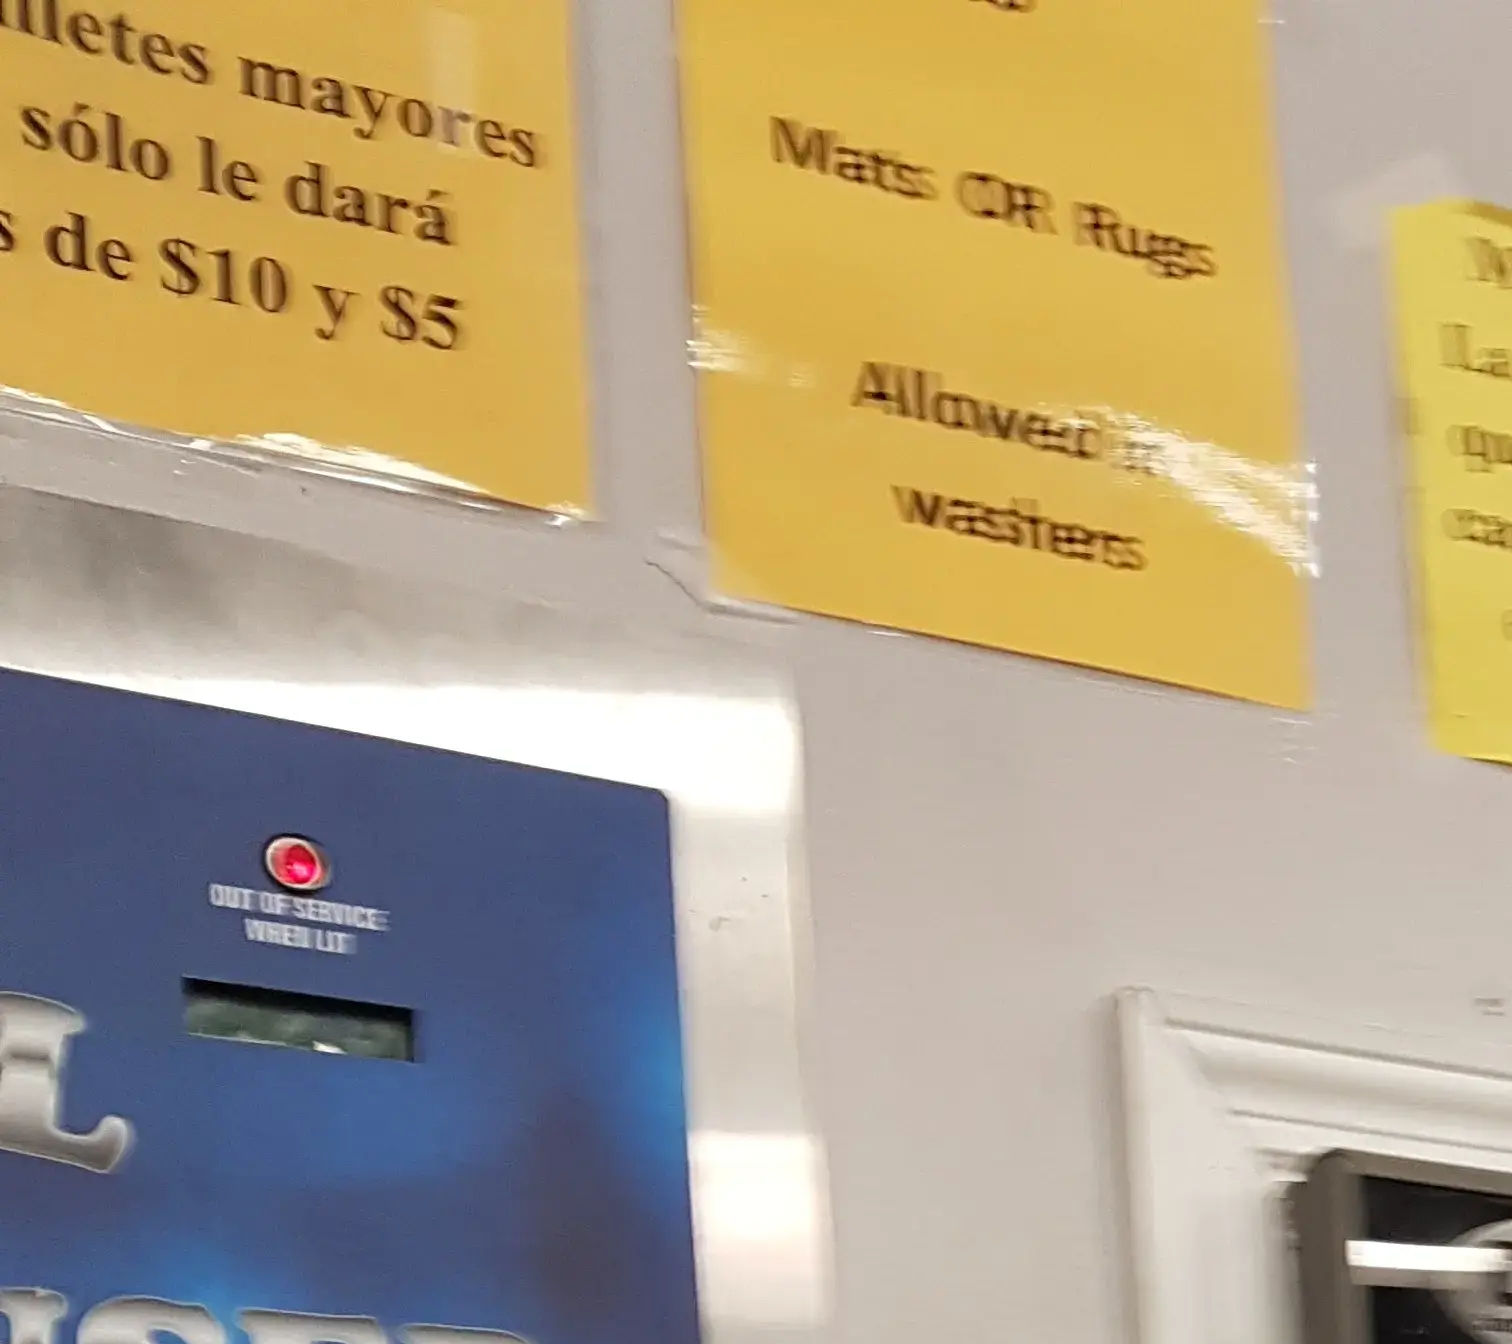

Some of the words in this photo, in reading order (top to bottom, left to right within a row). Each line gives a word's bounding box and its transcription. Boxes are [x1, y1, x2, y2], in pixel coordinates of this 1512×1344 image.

[0, 0, 212, 85] lletes
[239, 54, 542, 168] mayores
[19, 103, 171, 181] sólo
[196, 136, 260, 202] le
[283, 161, 455, 247] dará
[770, 115, 938, 201] Mats
[955, 169, 1057, 237] OR
[1074, 201, 1217, 281] Rugs
[44, 210, 133, 282] de
[158, 237, 289, 314] $10
[313, 283, 359, 341] y
[380, 284, 464, 351] $5
[851, 360, 1101, 459] Allowed
[891, 484, 1147, 572] washers
[208, 883, 254, 912] OUT
[260, 891, 292, 916] OF
[291, 895, 391, 932] SERVICE
[244, 917, 310, 949] WHEN
